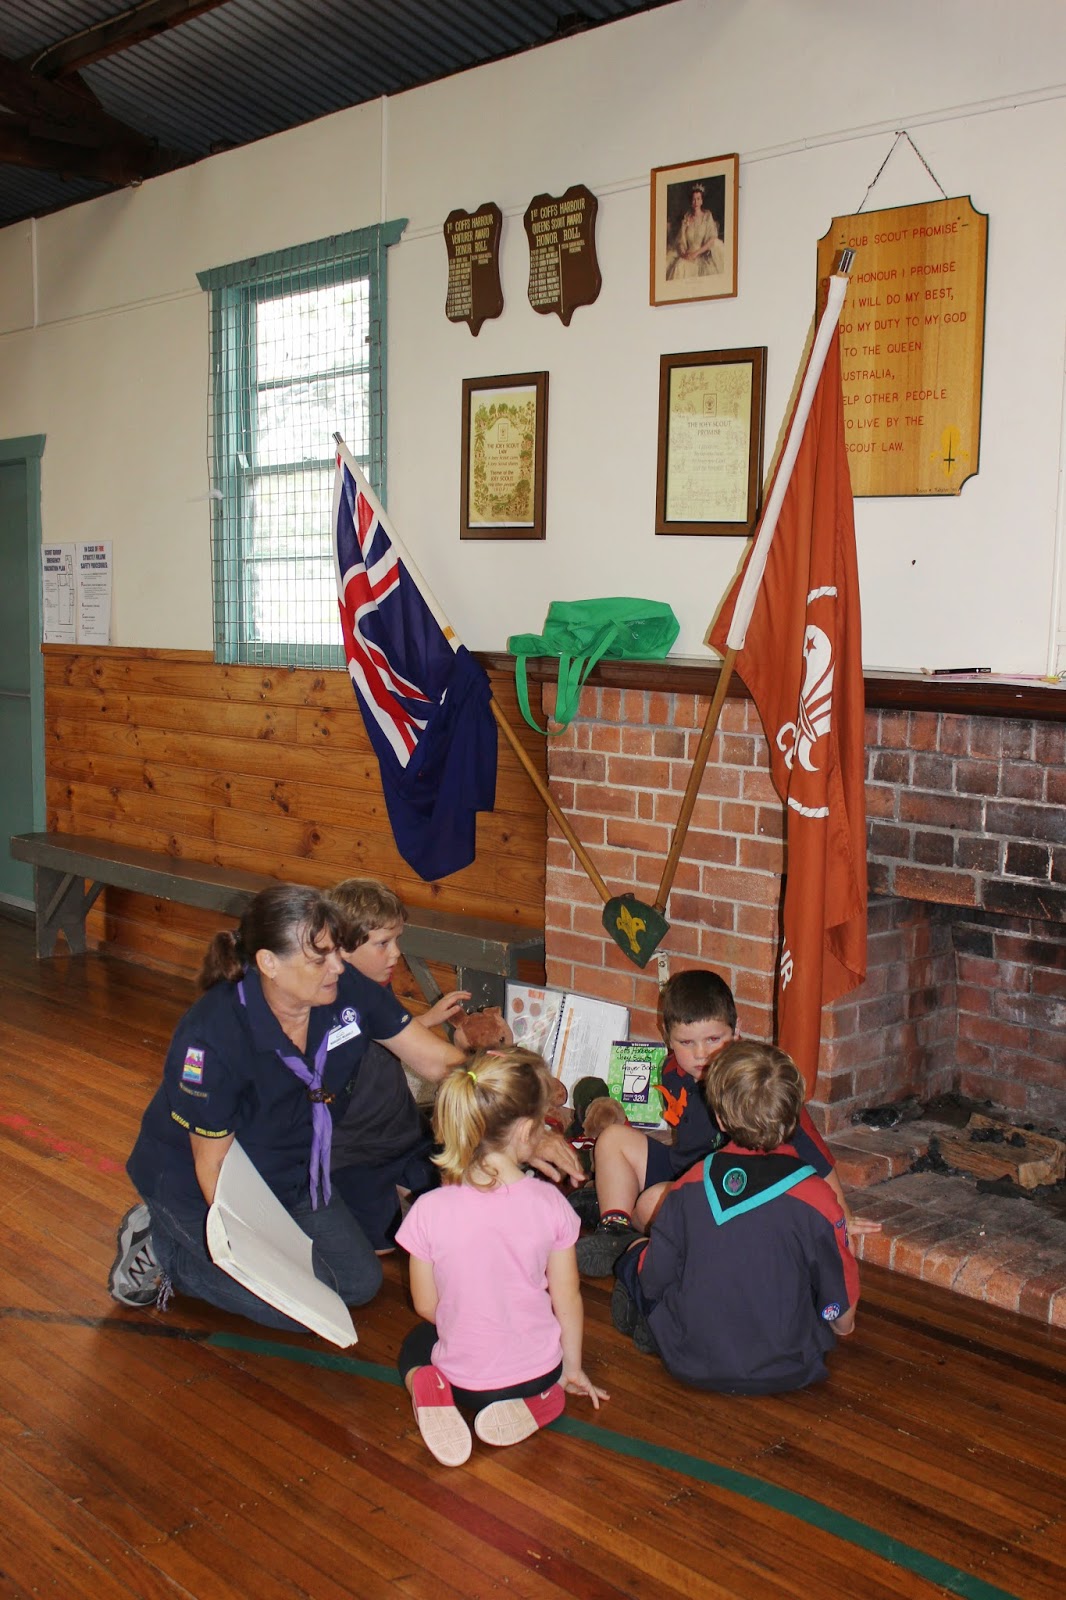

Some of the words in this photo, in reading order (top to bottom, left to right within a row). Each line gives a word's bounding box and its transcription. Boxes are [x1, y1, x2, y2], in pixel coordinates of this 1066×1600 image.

[540, 204, 558, 219] COFFS
[560, 198, 585, 214] HARBOUR
[455, 218, 470, 231] COFFS
[471, 213, 493, 228] HARBOUR
[531, 220, 550, 235] QUEENS
[550, 216, 565, 230] SCOUT
[566, 212, 583, 226] AWARD
[535, 231, 558, 247] HONOR
[563, 226, 580, 241] ROLL
[849, 237, 868, 248] CUB
[874, 229, 908, 245] SCOUT
[912, 222, 958, 239] PROMISE
[474, 240, 487, 252] ROLL
[857, 268, 897, 284] HONOUR
[902, 269, 905, 278] I
[910, 261, 956, 276] PROMISE
[859, 297, 881, 308] WILL
[886, 293, 900, 305] DO
[905, 291, 920, 303] MY
[925, 287, 954, 301] BEST,
[840, 324, 853, 335] DO
[857, 322, 871, 331] MY
[874, 319, 900, 331] DUTY
[906, 316, 920, 327] TO
[924, 314, 939, 325] MY
[943, 311, 967, 324] GOD
[844, 347, 857, 357] TO
[862, 345, 881, 356] THE
[887, 341, 922, 353] QUEEN
[842, 368, 895, 381] USTRALIA,
[842, 395, 860, 405] ELP
[864, 392, 899, 404] OTHER
[905, 388, 947, 401] PEOPLE
[857, 417, 880, 429] LIVE
[886, 416, 900, 428] BY
[905, 415, 925, 426] THE
[845, 442, 876, 453] SCOUT
[881, 442, 904, 452] LAW.
[621, 1063, 640, 1075] Prayer
[633, 1094, 645, 1102] 320
